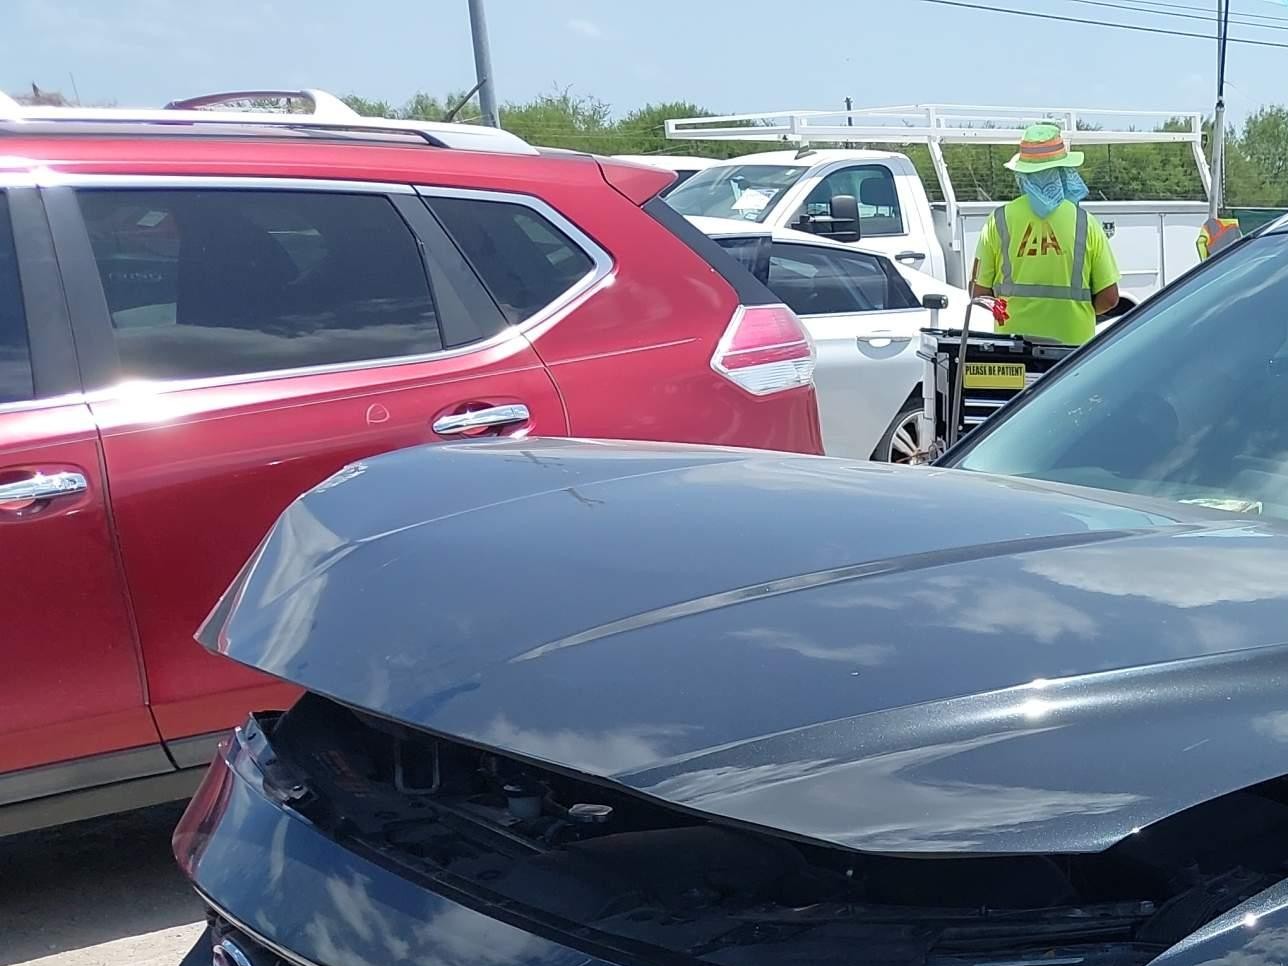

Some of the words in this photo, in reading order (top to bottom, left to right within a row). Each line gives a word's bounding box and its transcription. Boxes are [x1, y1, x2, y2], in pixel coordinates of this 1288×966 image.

[965, 365, 988, 376] PLEASE
[988, 365, 996, 376] BE
[997, 366, 1023, 377] PATIENT
